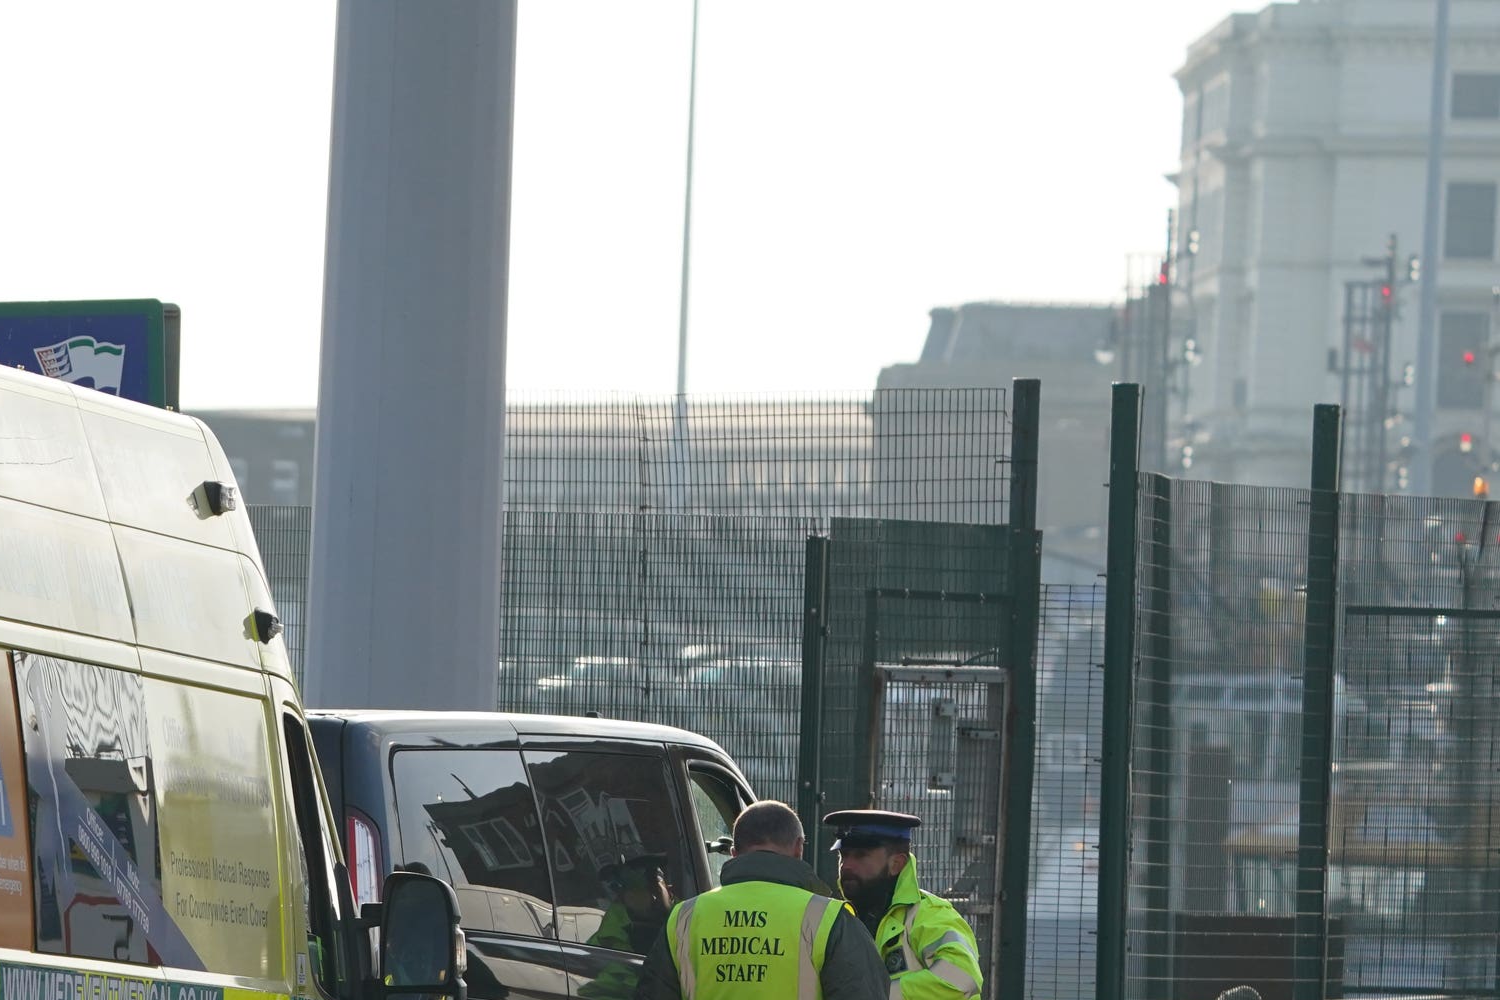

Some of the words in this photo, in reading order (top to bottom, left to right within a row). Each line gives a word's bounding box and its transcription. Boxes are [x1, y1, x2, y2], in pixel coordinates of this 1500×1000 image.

[171, 851, 211, 881] Professional
[212, 857, 237, 884] Medical
[238, 861, 270, 891] Response
[176, 892, 188, 916] For
[189, 894, 229, 927] Countrywide
[230, 900, 249, 926] Event
[250, 902, 268, 928] Cover
[723, 910, 768, 928] MMS
[700, 936, 785, 956] MEDICAL
[716, 963, 768, 982] STAFF
